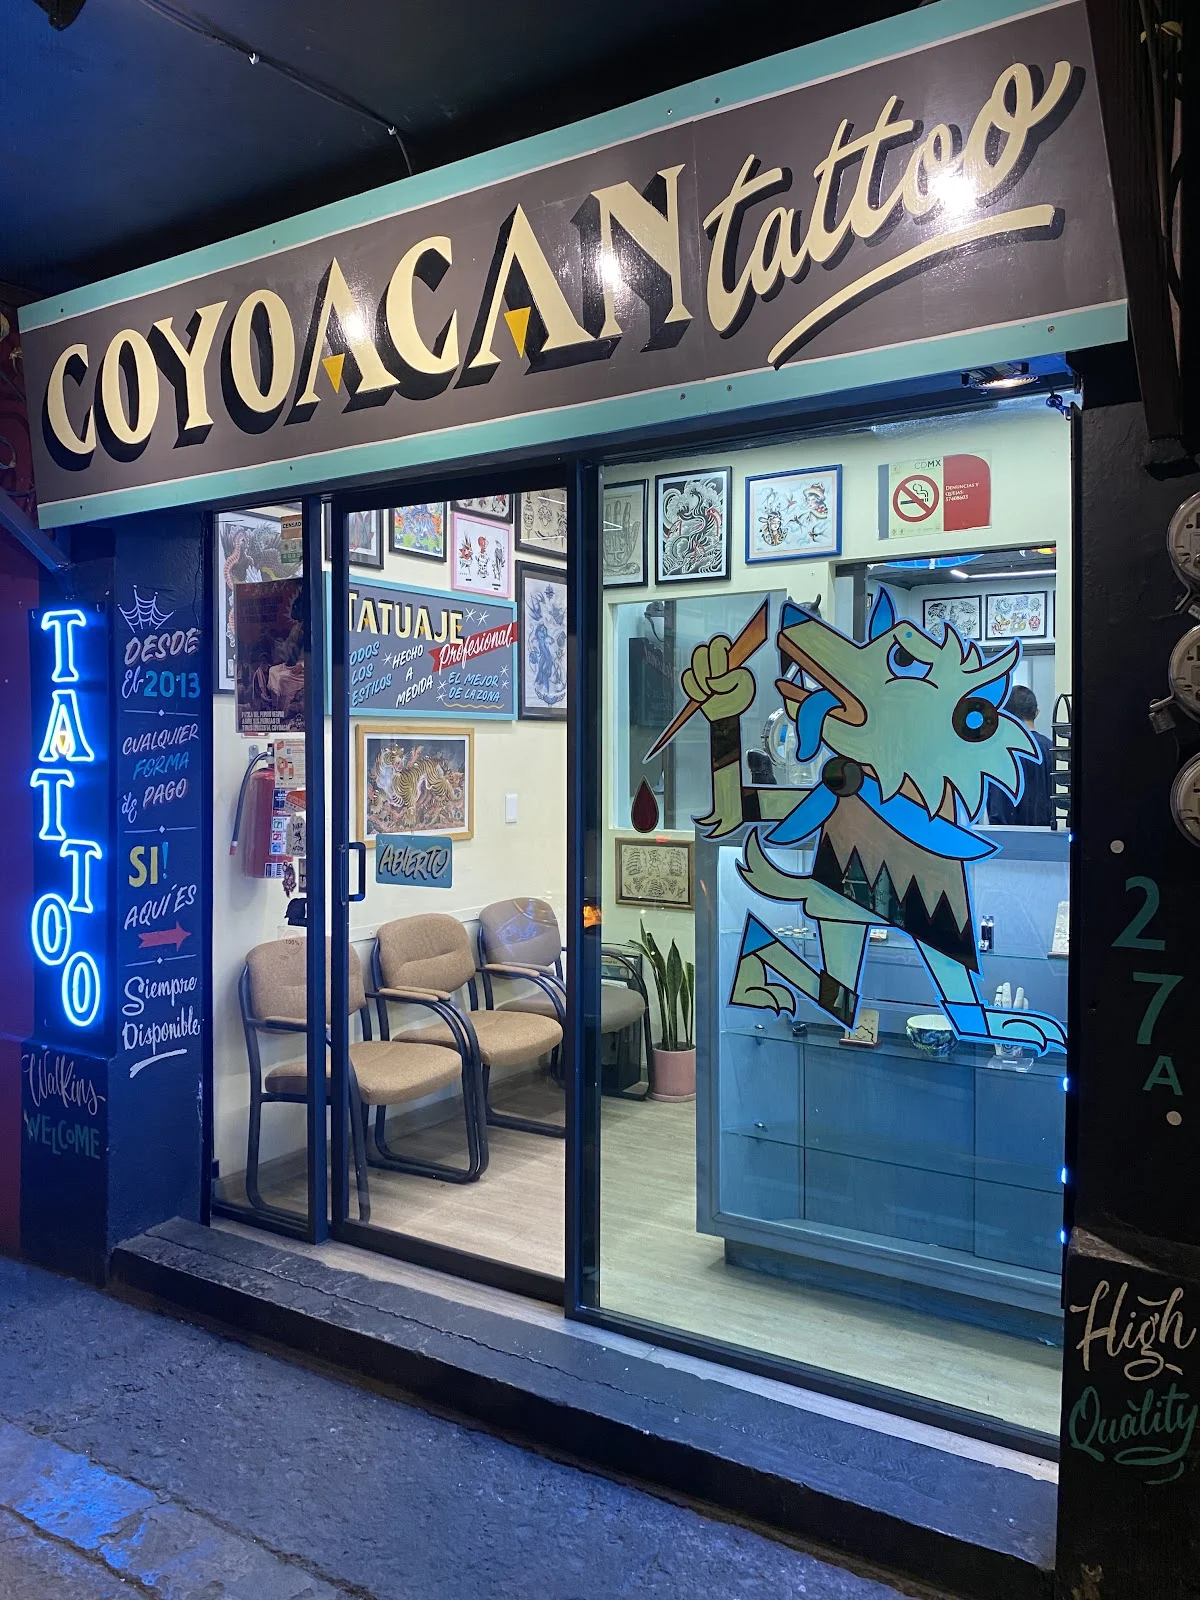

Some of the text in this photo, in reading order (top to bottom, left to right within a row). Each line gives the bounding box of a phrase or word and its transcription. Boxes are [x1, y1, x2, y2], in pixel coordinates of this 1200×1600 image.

[43, 60, 1080, 468] COYOACAN tattoo
[914, 459, 942, 470] CDMX
[945, 482, 975, 491] DENUNCIAS
[124, 627, 200, 666] DESDE
[349, 641, 380, 667] ODOS
[392, 644, 425, 670] HECHO
[143, 670, 200, 698] 2013
[351, 662, 374, 687] LOS
[351, 673, 393, 708] ESTILOS
[405, 666, 414, 682] A
[448, 672, 499, 688] EL MEJOR
[395, 674, 434, 708] MEDIDA
[448, 687, 463, 700] DE
[122, 723, 200, 756] CUALQUIER
[132, 751, 190, 781] FORMA
[142, 778, 188, 809] PAGO
[30, 609, 103, 1027] TATTOO
[377, 843, 451, 881] ABIERTO
[121, 976, 198, 1017] Siempre
[121, 1005, 201, 1055] Disponible
[24, 1111, 101, 1160] WELCOME
[1069, 1279, 1197, 1382] High
[1068, 1382, 1199, 1467] Quality
